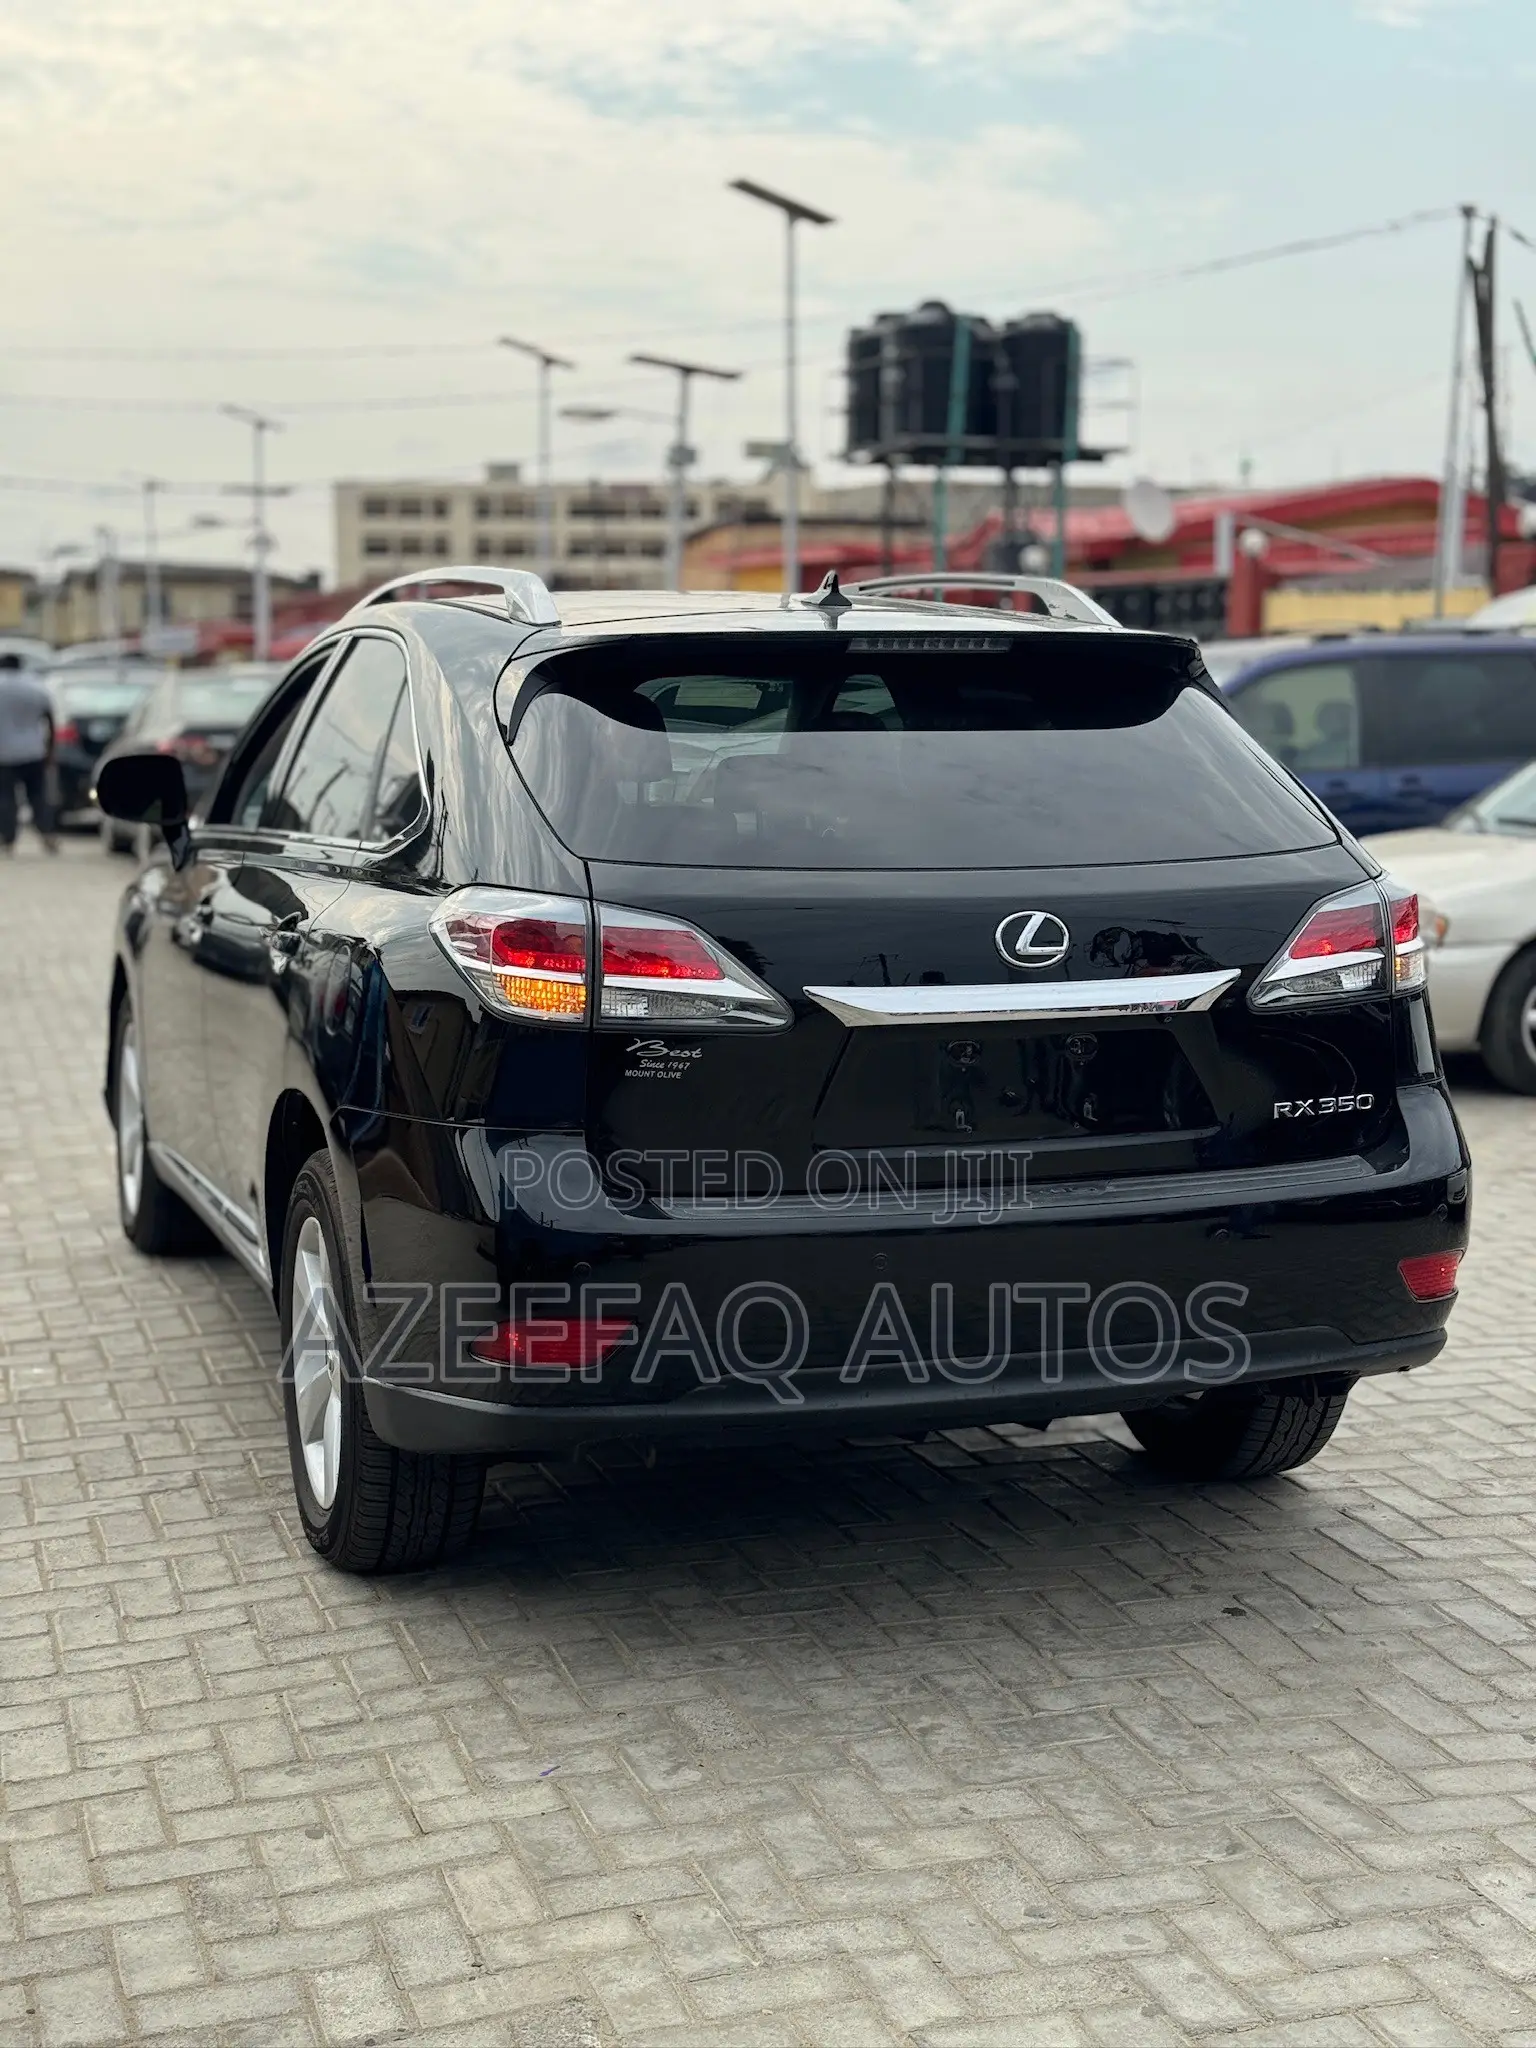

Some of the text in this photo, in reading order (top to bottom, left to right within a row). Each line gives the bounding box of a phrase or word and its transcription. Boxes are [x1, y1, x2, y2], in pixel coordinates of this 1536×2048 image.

[639, 1059, 691, 1070] Since 1967
[624, 1069, 682, 1079] MOUNT OLIVE
